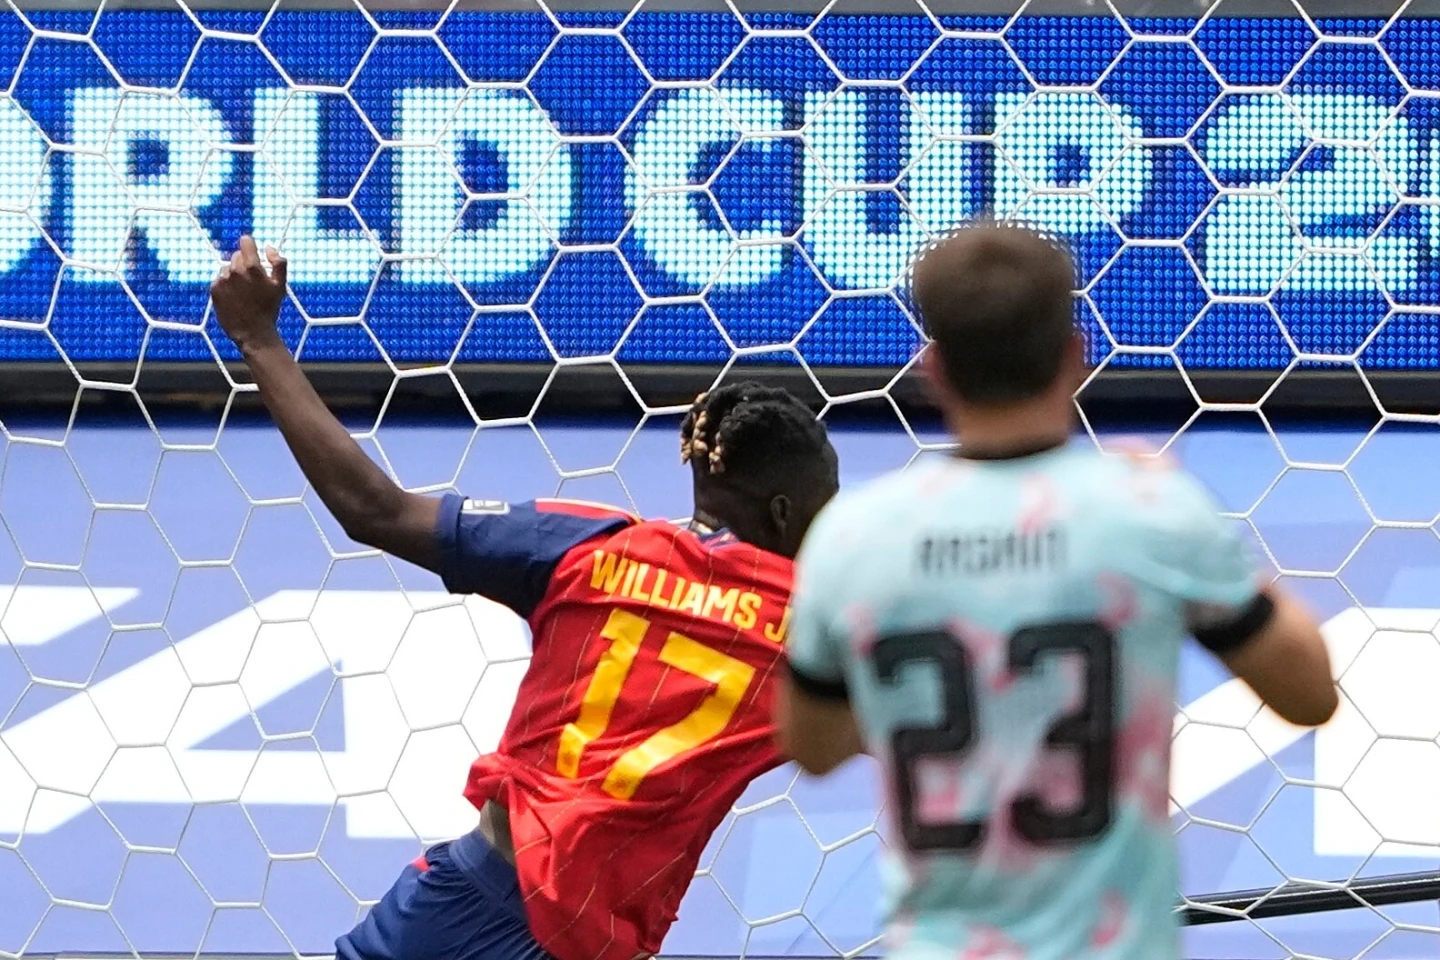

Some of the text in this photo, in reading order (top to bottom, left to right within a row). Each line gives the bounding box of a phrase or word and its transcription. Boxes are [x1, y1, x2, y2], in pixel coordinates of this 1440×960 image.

[624, 87, 1154, 290] CUP
[1205, 92, 1440, 291] 2
[589, 549, 764, 630] WILLIAMS
[556, 607, 757, 803] 17
[872, 619, 1115, 853] 23
